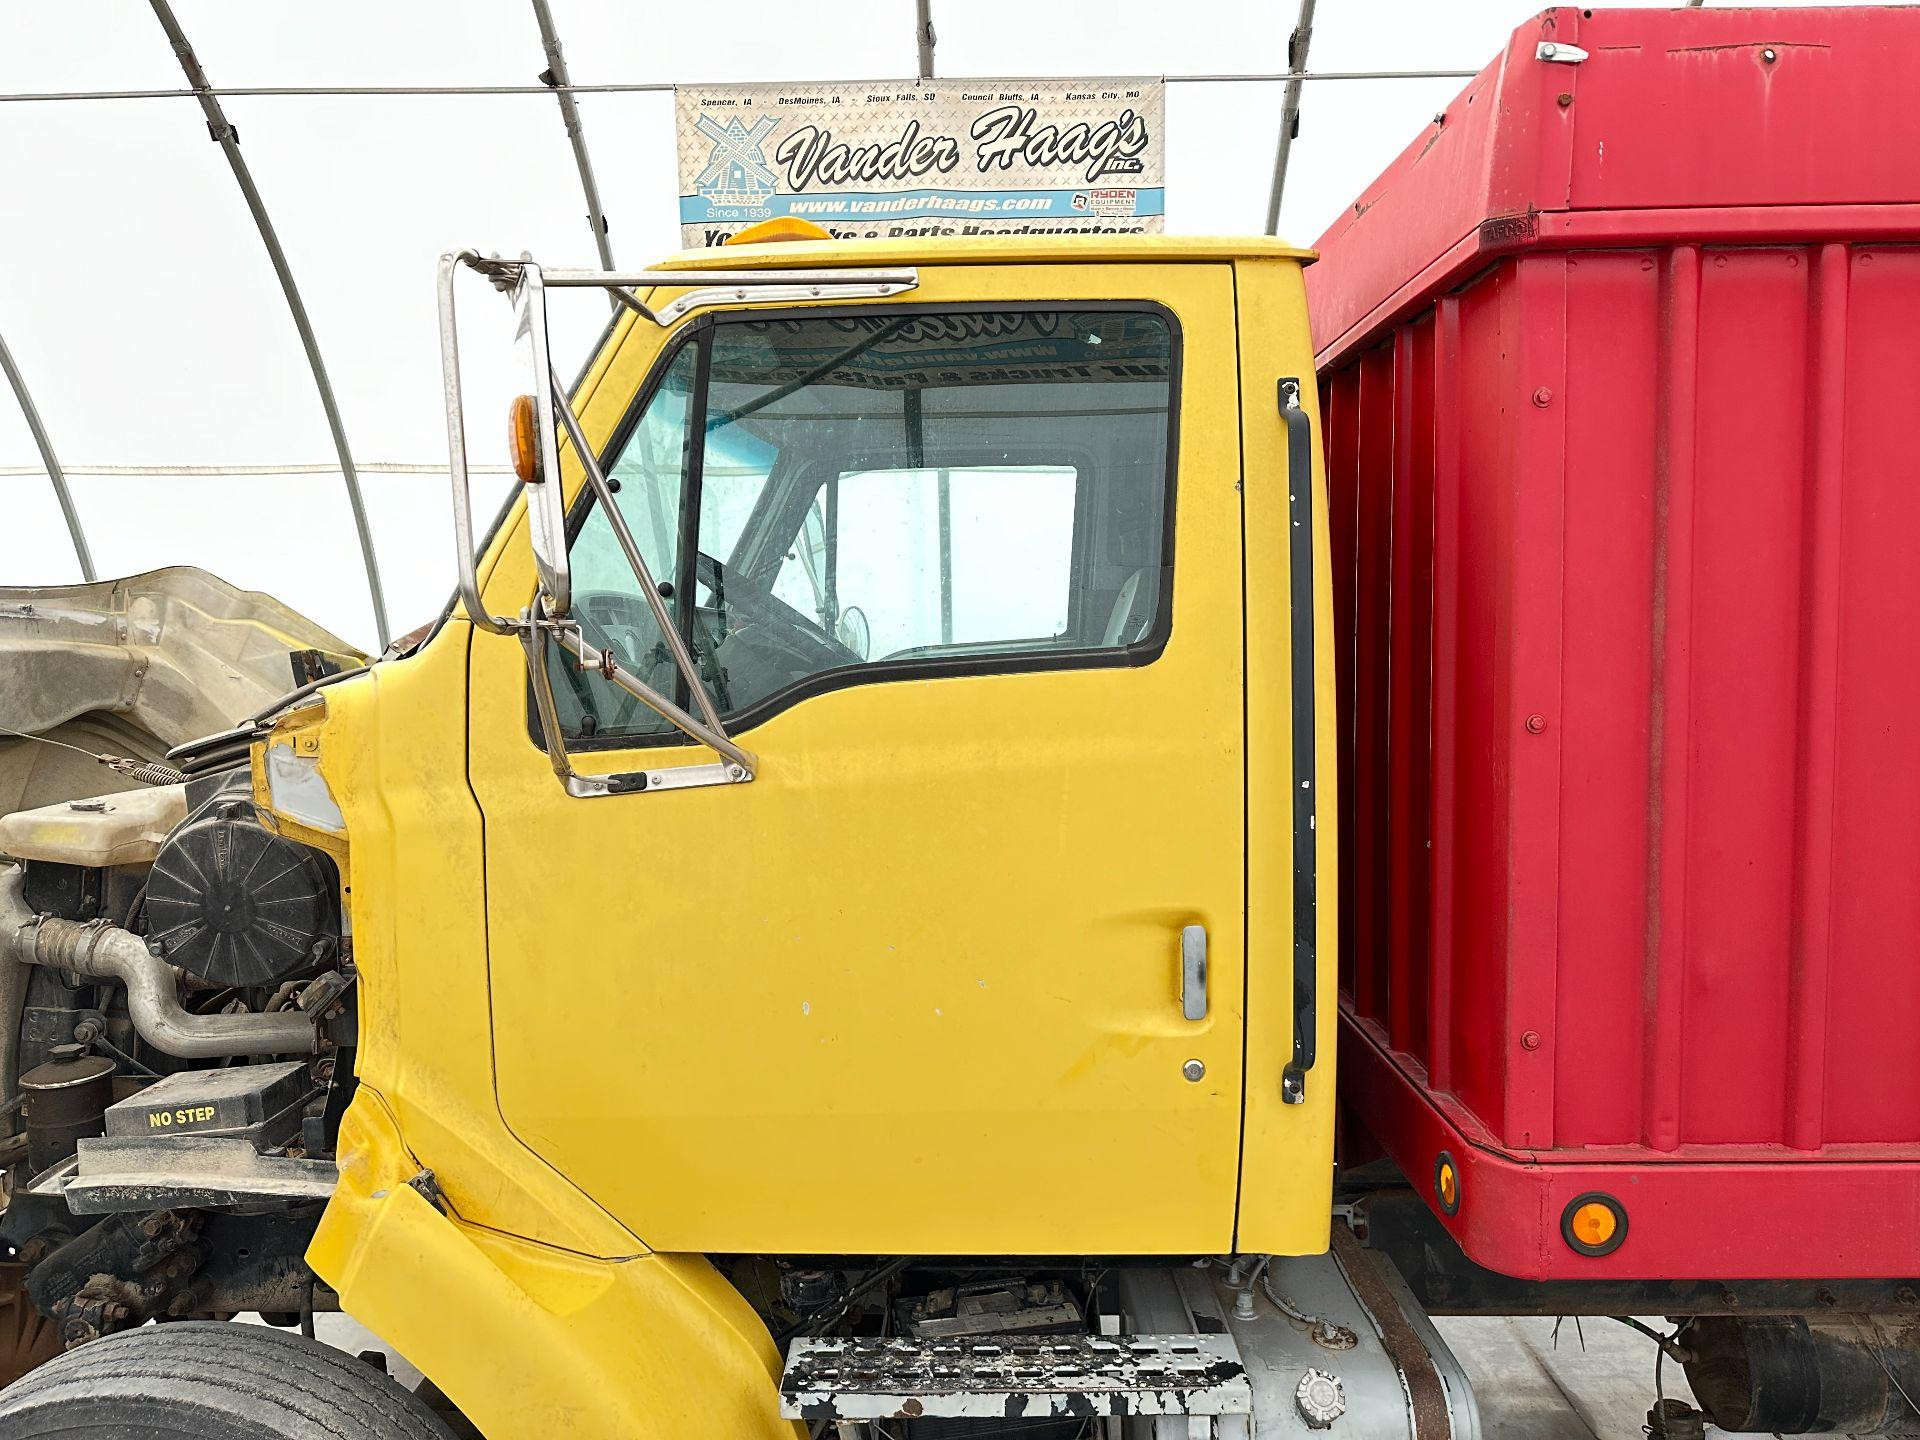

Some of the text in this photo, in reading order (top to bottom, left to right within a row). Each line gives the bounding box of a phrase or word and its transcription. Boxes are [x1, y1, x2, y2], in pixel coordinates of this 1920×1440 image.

[701, 98, 738, 107] Spencer,
[831, 96, 841, 104] IA
[866, 95, 890, 103] Sioux
[896, 93, 918, 102] Falls,
[923, 93, 936, 101] SD
[961, 93, 993, 101] Council
[999, 93, 1025, 102] Bluffs,
[1030, 93, 1039, 101] IA
[1065, 93, 1096, 101] Kansas
[1126, 91, 1140, 99] MO
[776, 105, 1148, 192] Vander Haag's
[1103, 157, 1144, 173] Inc.
[706, 208, 772, 218] Since 1939
[789, 196, 1052, 214] www.vanderhaags.com
[149, 1106, 215, 1127] NO STEP
